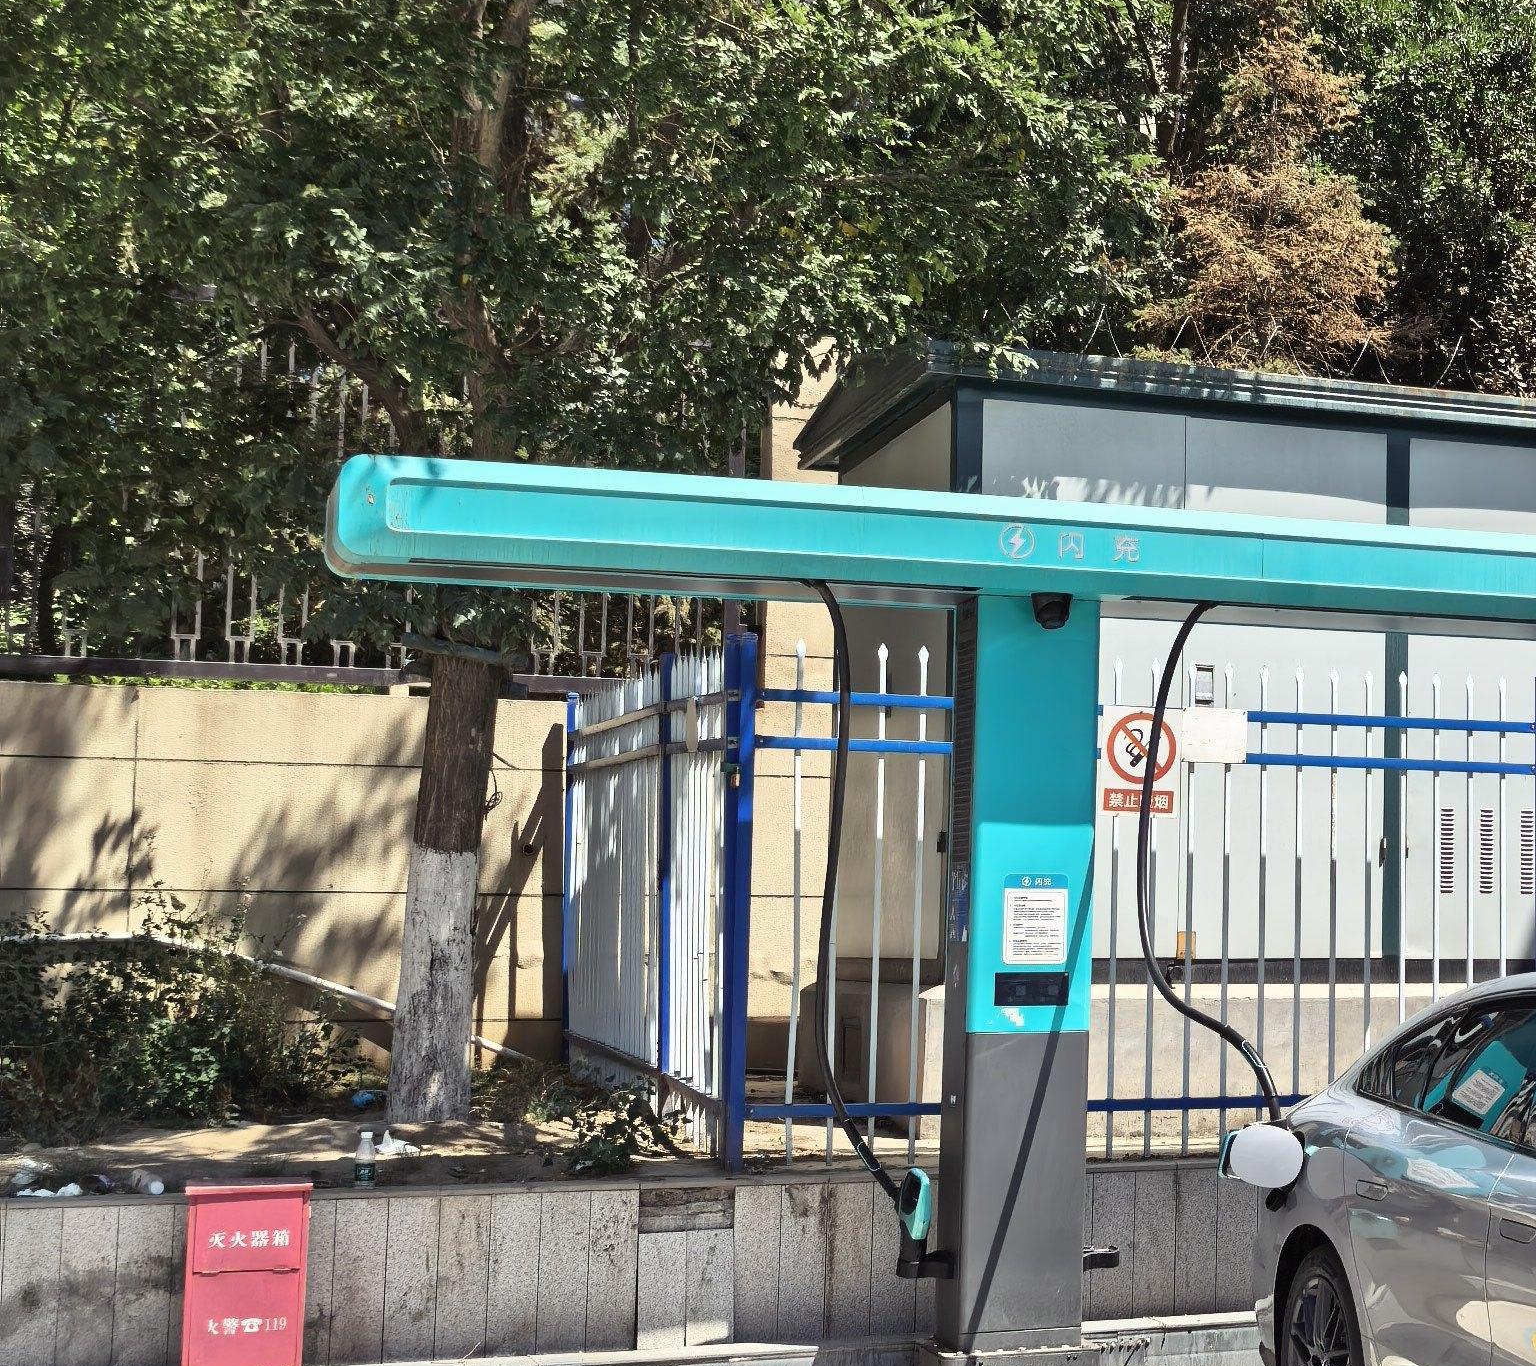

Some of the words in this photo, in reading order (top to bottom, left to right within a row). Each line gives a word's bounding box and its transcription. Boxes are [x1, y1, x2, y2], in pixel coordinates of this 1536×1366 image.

[1058, 531, 1141, 563] 闪充
[1108, 791, 1169, 810] 禁止烟
[1034, 877, 1052, 887] 闪充
[208, 1227, 290, 1248] 灭火器箱
[265, 1317, 288, 1331] 119
